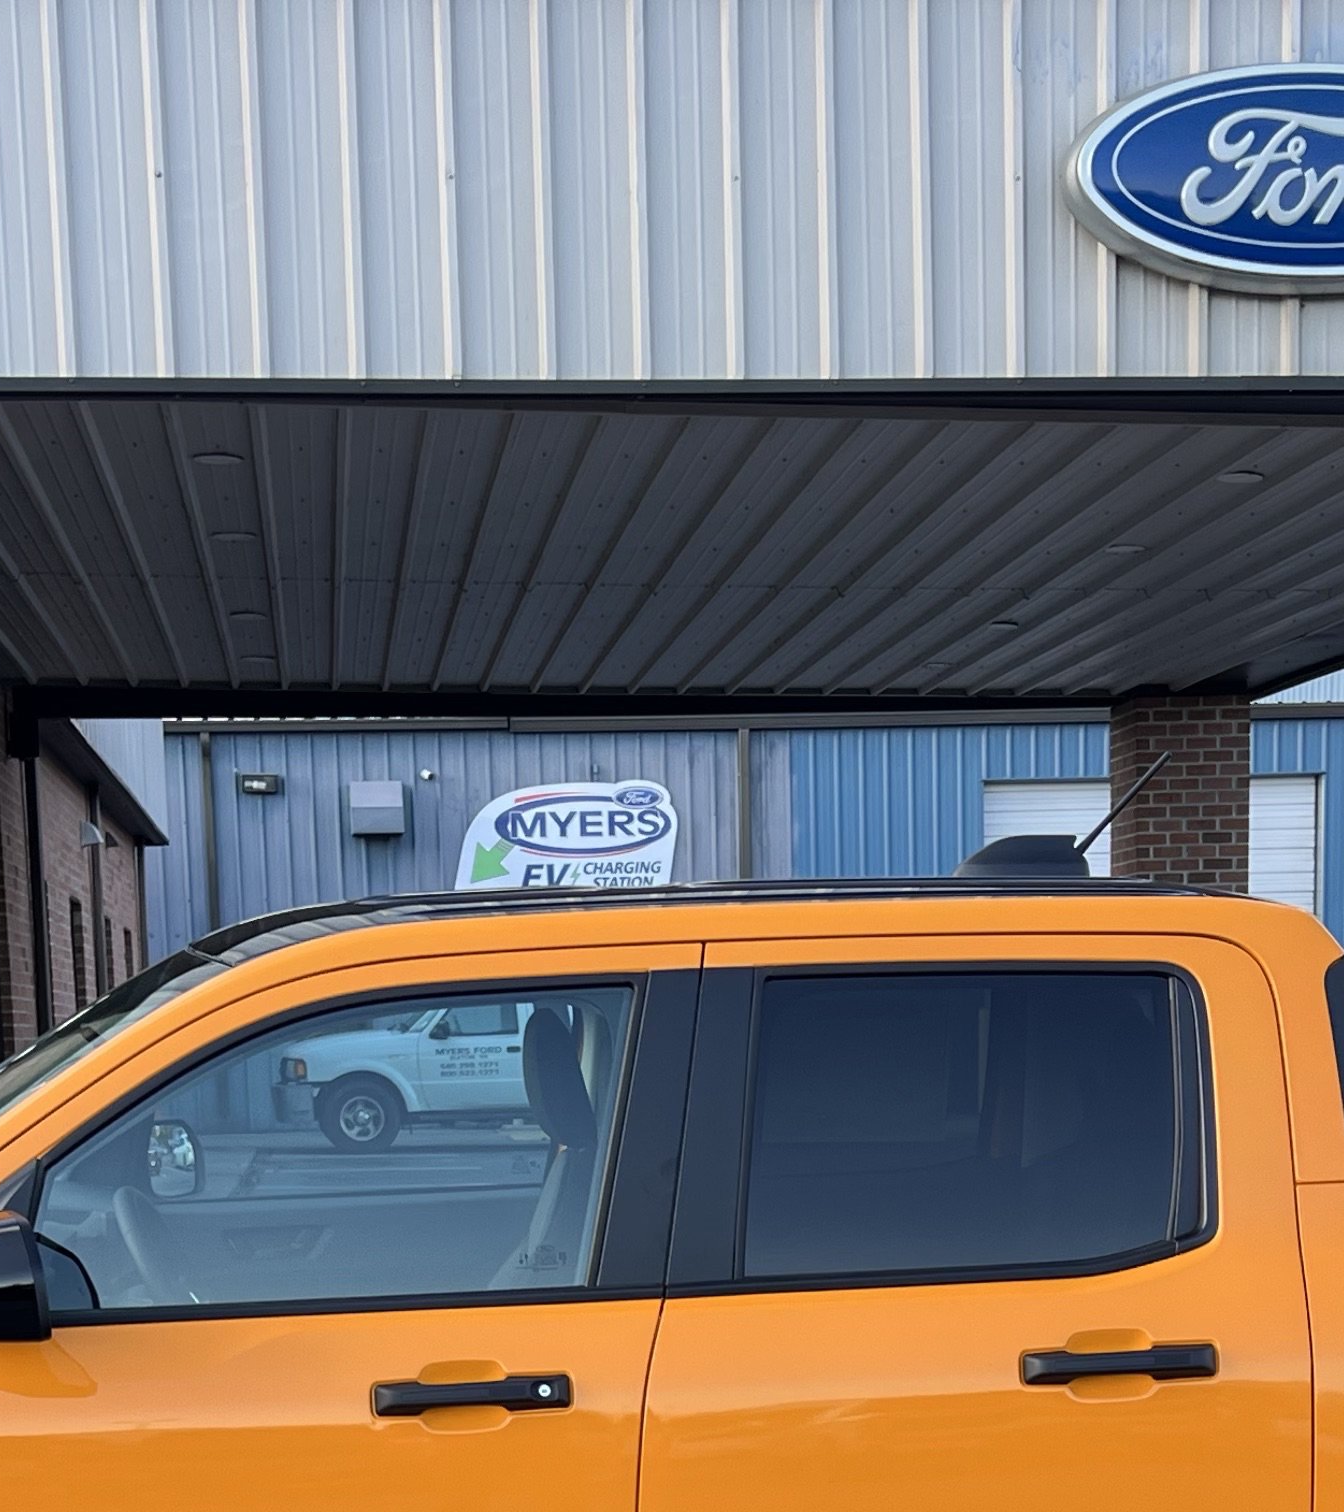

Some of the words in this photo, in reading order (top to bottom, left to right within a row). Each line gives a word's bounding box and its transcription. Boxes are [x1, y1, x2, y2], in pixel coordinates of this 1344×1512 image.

[623, 791, 652, 804] Ford
[511, 810, 660, 838] MYERS
[583, 861, 662, 875] CHARGING
[592, 876, 655, 888] STATION
[474, 1046, 502, 1054] FORD
